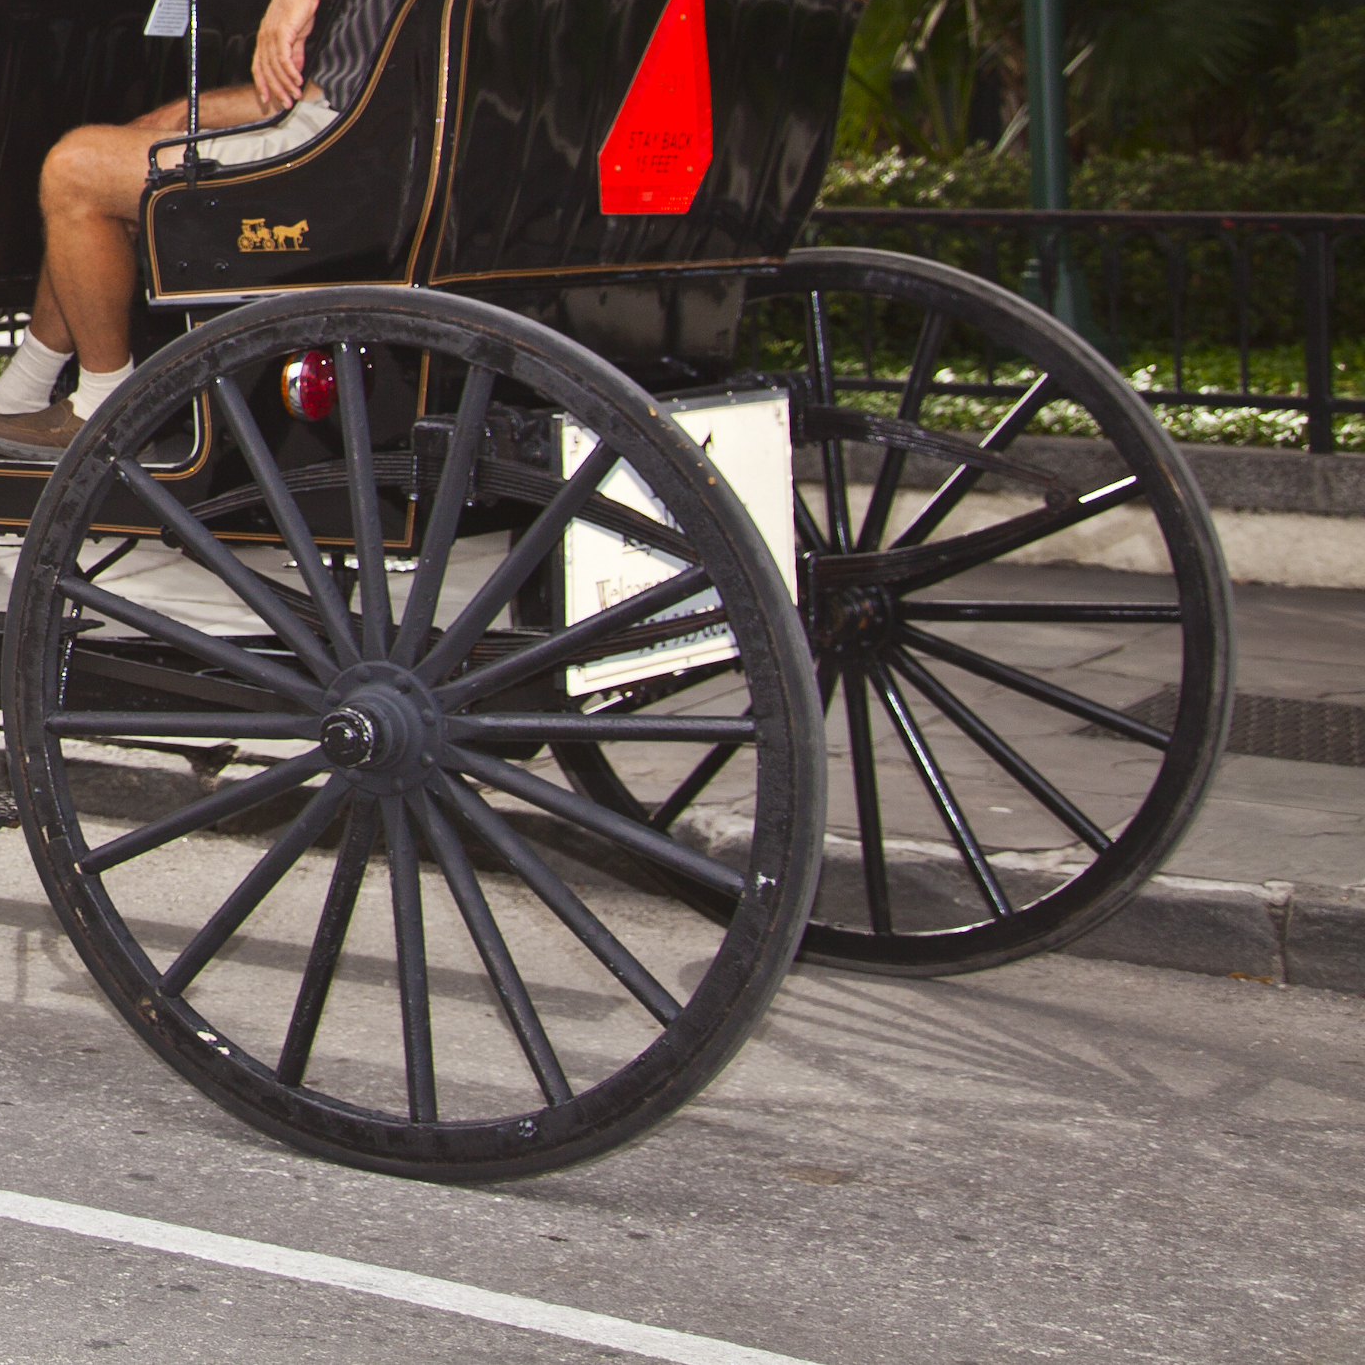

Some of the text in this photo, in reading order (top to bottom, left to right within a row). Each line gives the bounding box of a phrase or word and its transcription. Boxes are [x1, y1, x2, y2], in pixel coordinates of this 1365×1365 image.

[628, 131, 694, 151] STAY BACK
[649, 155, 680, 174] FEET
